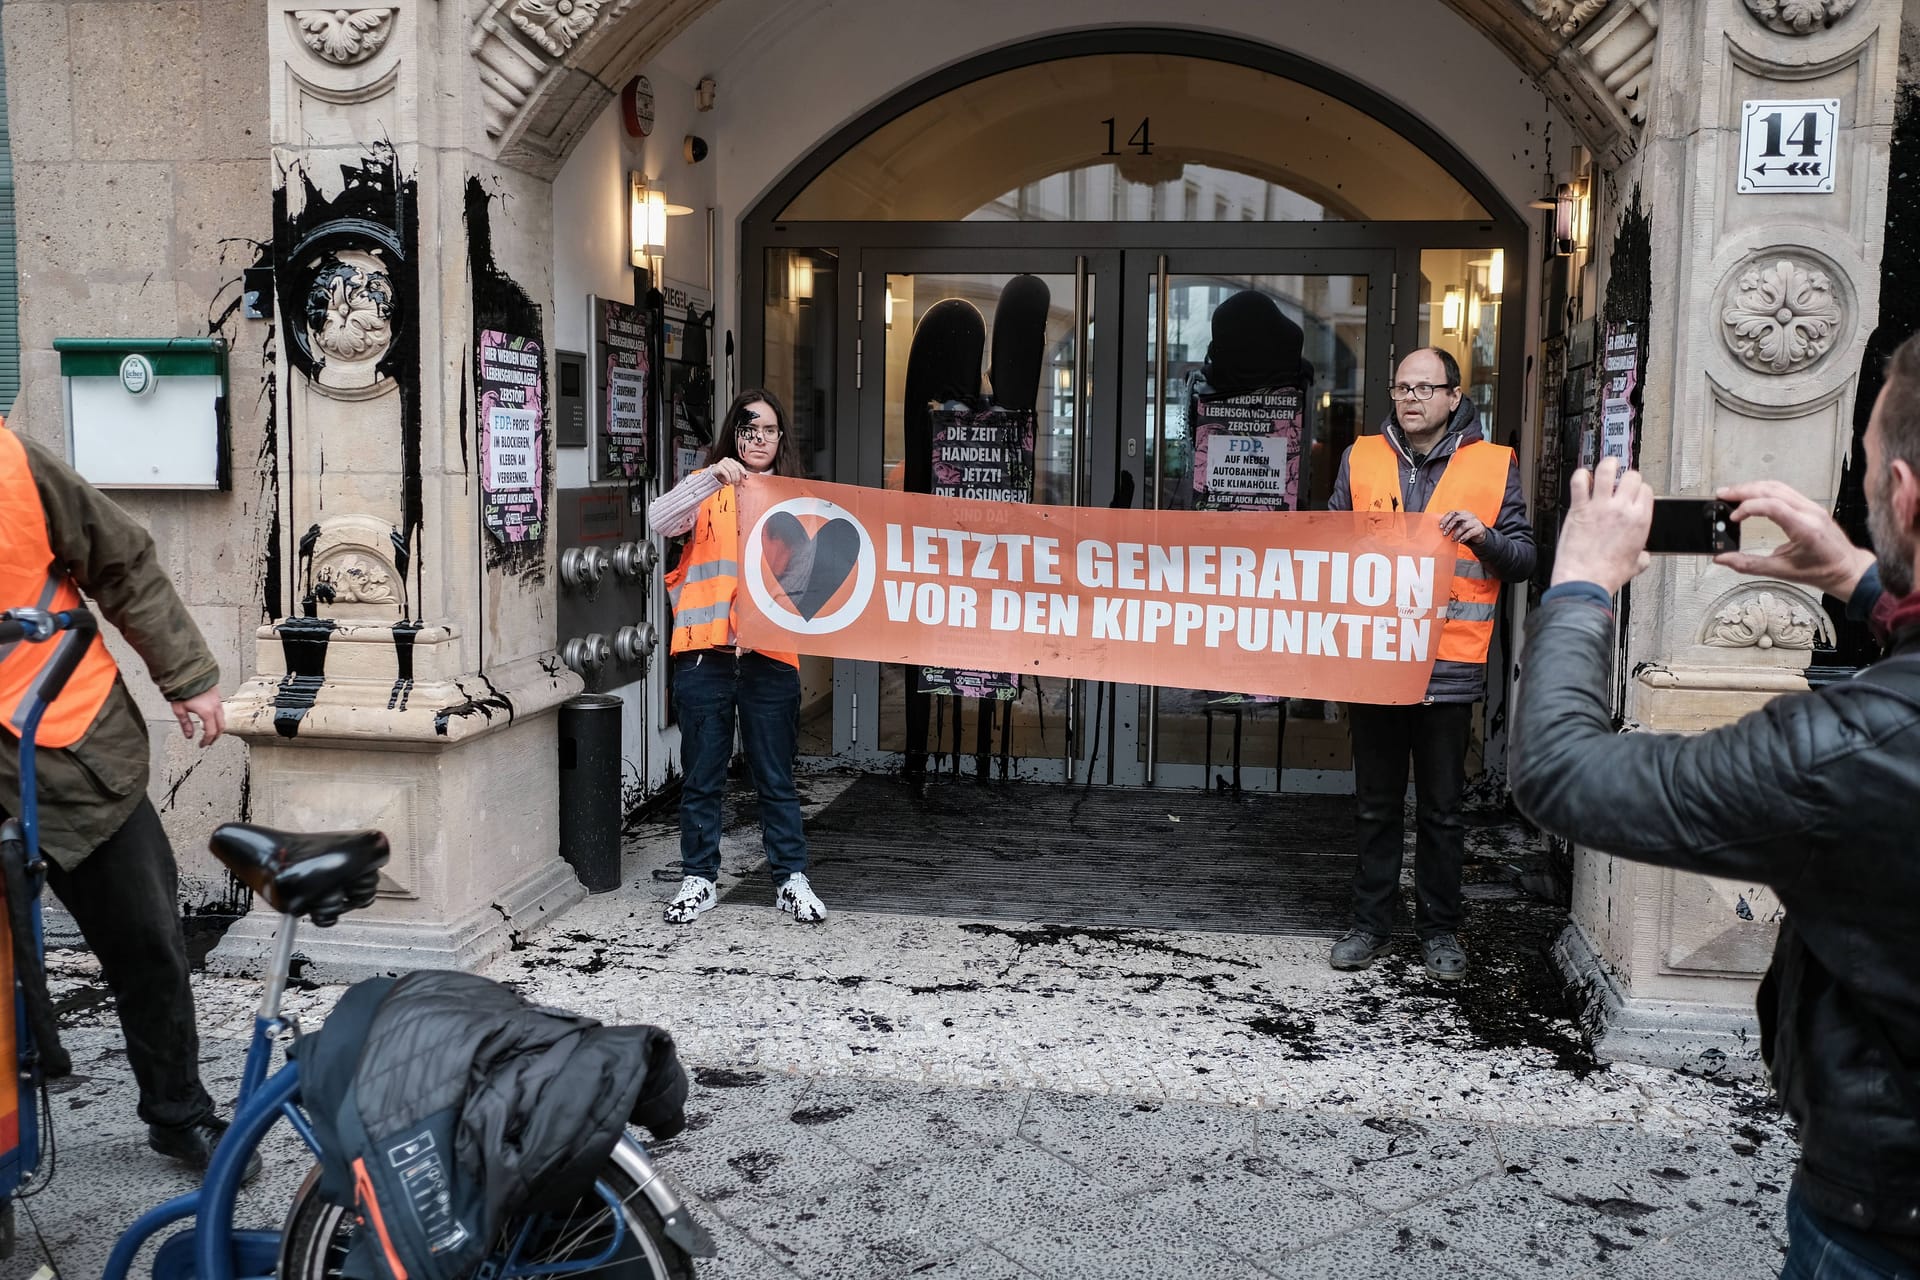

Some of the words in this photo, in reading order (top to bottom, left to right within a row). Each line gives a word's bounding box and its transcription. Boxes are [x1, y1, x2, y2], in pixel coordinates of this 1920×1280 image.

[1101, 116, 1155, 156] 14
[1758, 112, 1823, 158] 14
[663, 287, 689, 310] ZIEGEL
[498, 348, 519, 365] WERDEN
[519, 352, 538, 368] UNSERE
[486, 366, 537, 387] LEBENSGRUNDLAGEN
[1264, 396, 1297, 406] UNSERE
[494, 415, 512, 430] FDP:
[512, 419, 530, 431] PROFIS
[1228, 420, 1271, 432] ZERSTÖRT
[947, 427, 967, 441] DIE
[971, 428, 998, 442] ZEIT
[493, 436, 500, 448] IM
[501, 436, 531, 450] BLOCKIEREN,
[1229, 440, 1264, 453] FDP:
[499, 454, 517, 466] KLEBEN
[518, 455, 526, 466] AM
[941, 447, 1001, 462] HANDELN
[1225, 455, 1241, 463] AUF
[1243, 456, 1270, 465] NEUEN
[497, 472, 529, 484] VERBRENNER.
[962, 467, 1002, 482] JETZT!
[1213, 467, 1269, 477] AUTOBAHNEN
[1271, 469, 1280, 478] IN
[1212, 479, 1225, 487] DIE
[1227, 478, 1280, 490] KLIMAHÖLLE.
[960, 484, 1028, 504] LÖSUNGEN
[1234, 496, 1253, 504] AUCH
[1254, 497, 1282, 505] ANDERS!
[886, 523, 1061, 585] LETZTE
[1076, 539, 1435, 609] GENERATION
[883, 579, 979, 628] VOR
[990, 588, 1079, 637] DEN
[1091, 596, 1432, 662] KIPPPUNKTEN
